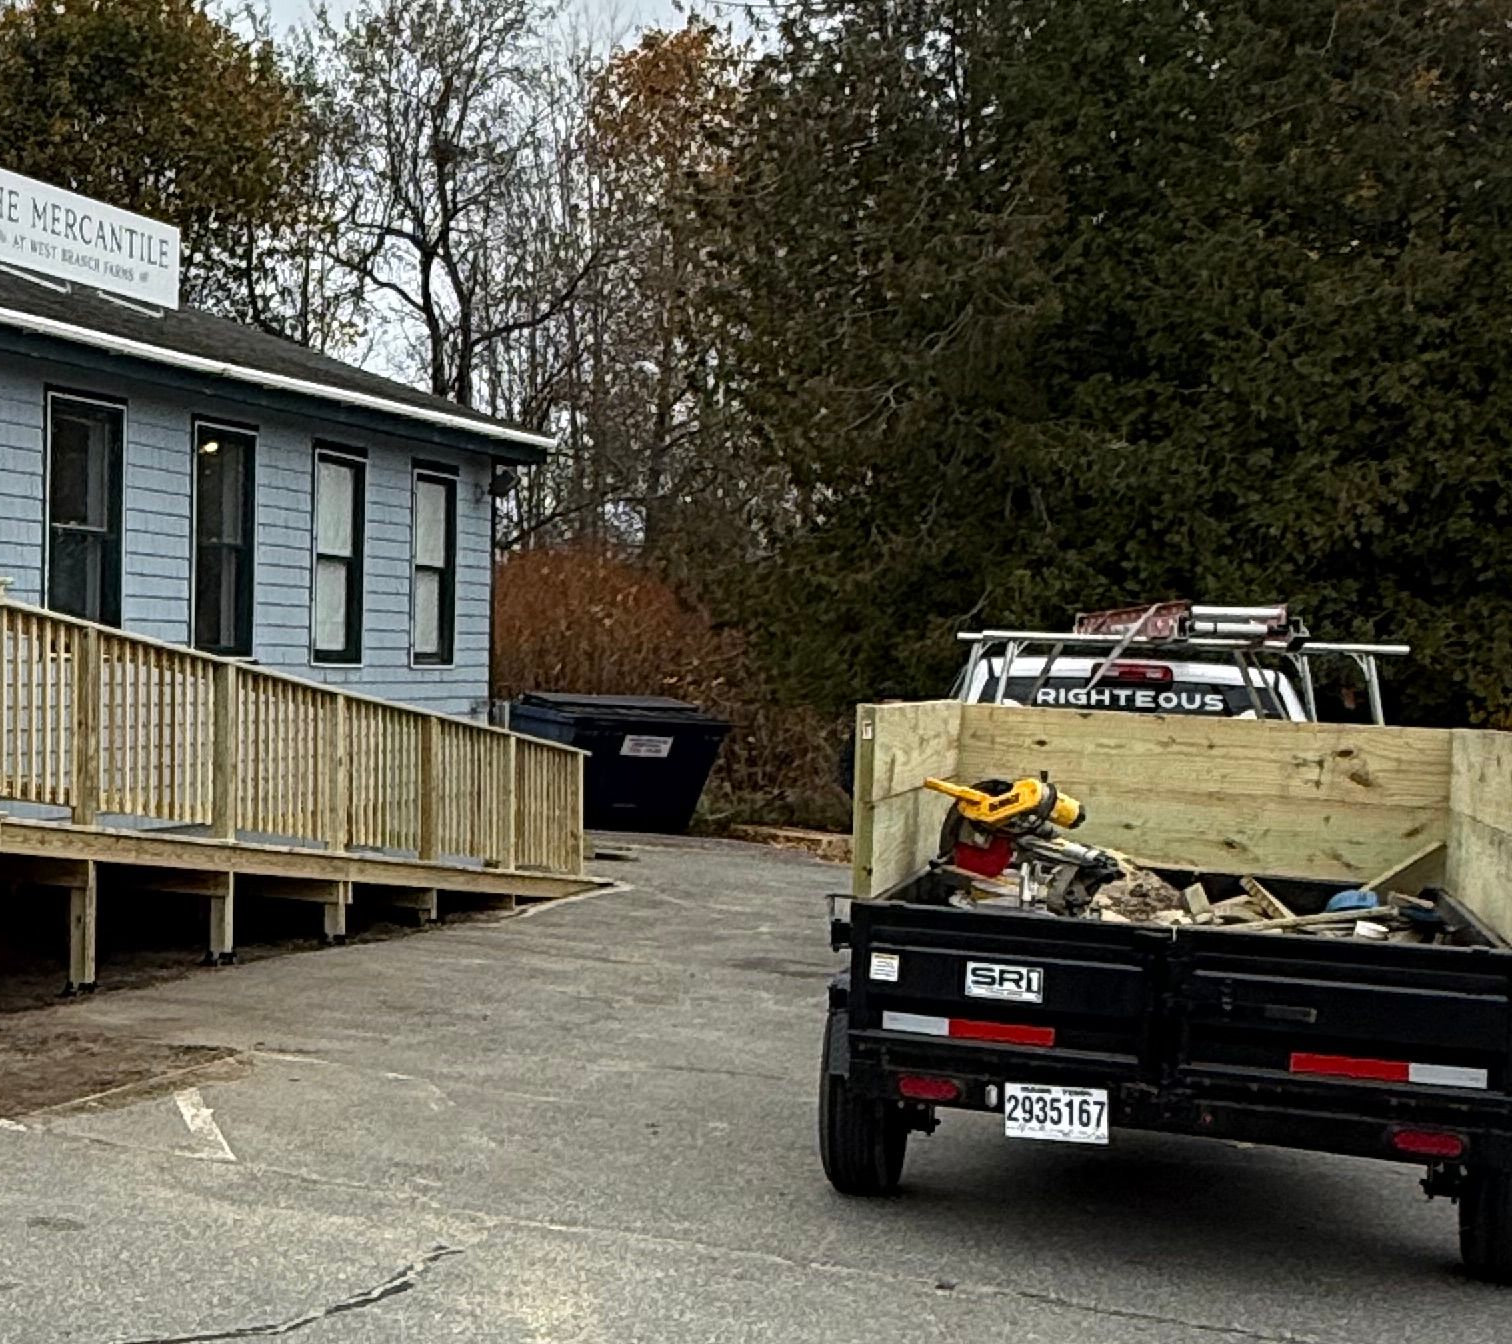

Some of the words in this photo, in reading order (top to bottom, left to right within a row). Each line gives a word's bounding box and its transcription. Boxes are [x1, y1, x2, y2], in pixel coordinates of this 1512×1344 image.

[31, 197, 170, 269] MERCANTILE
[31, 239, 57, 259] WEST
[1037, 688, 1224, 711] RIGHTEOUS
[1006, 1094, 1106, 1128] 2935167
